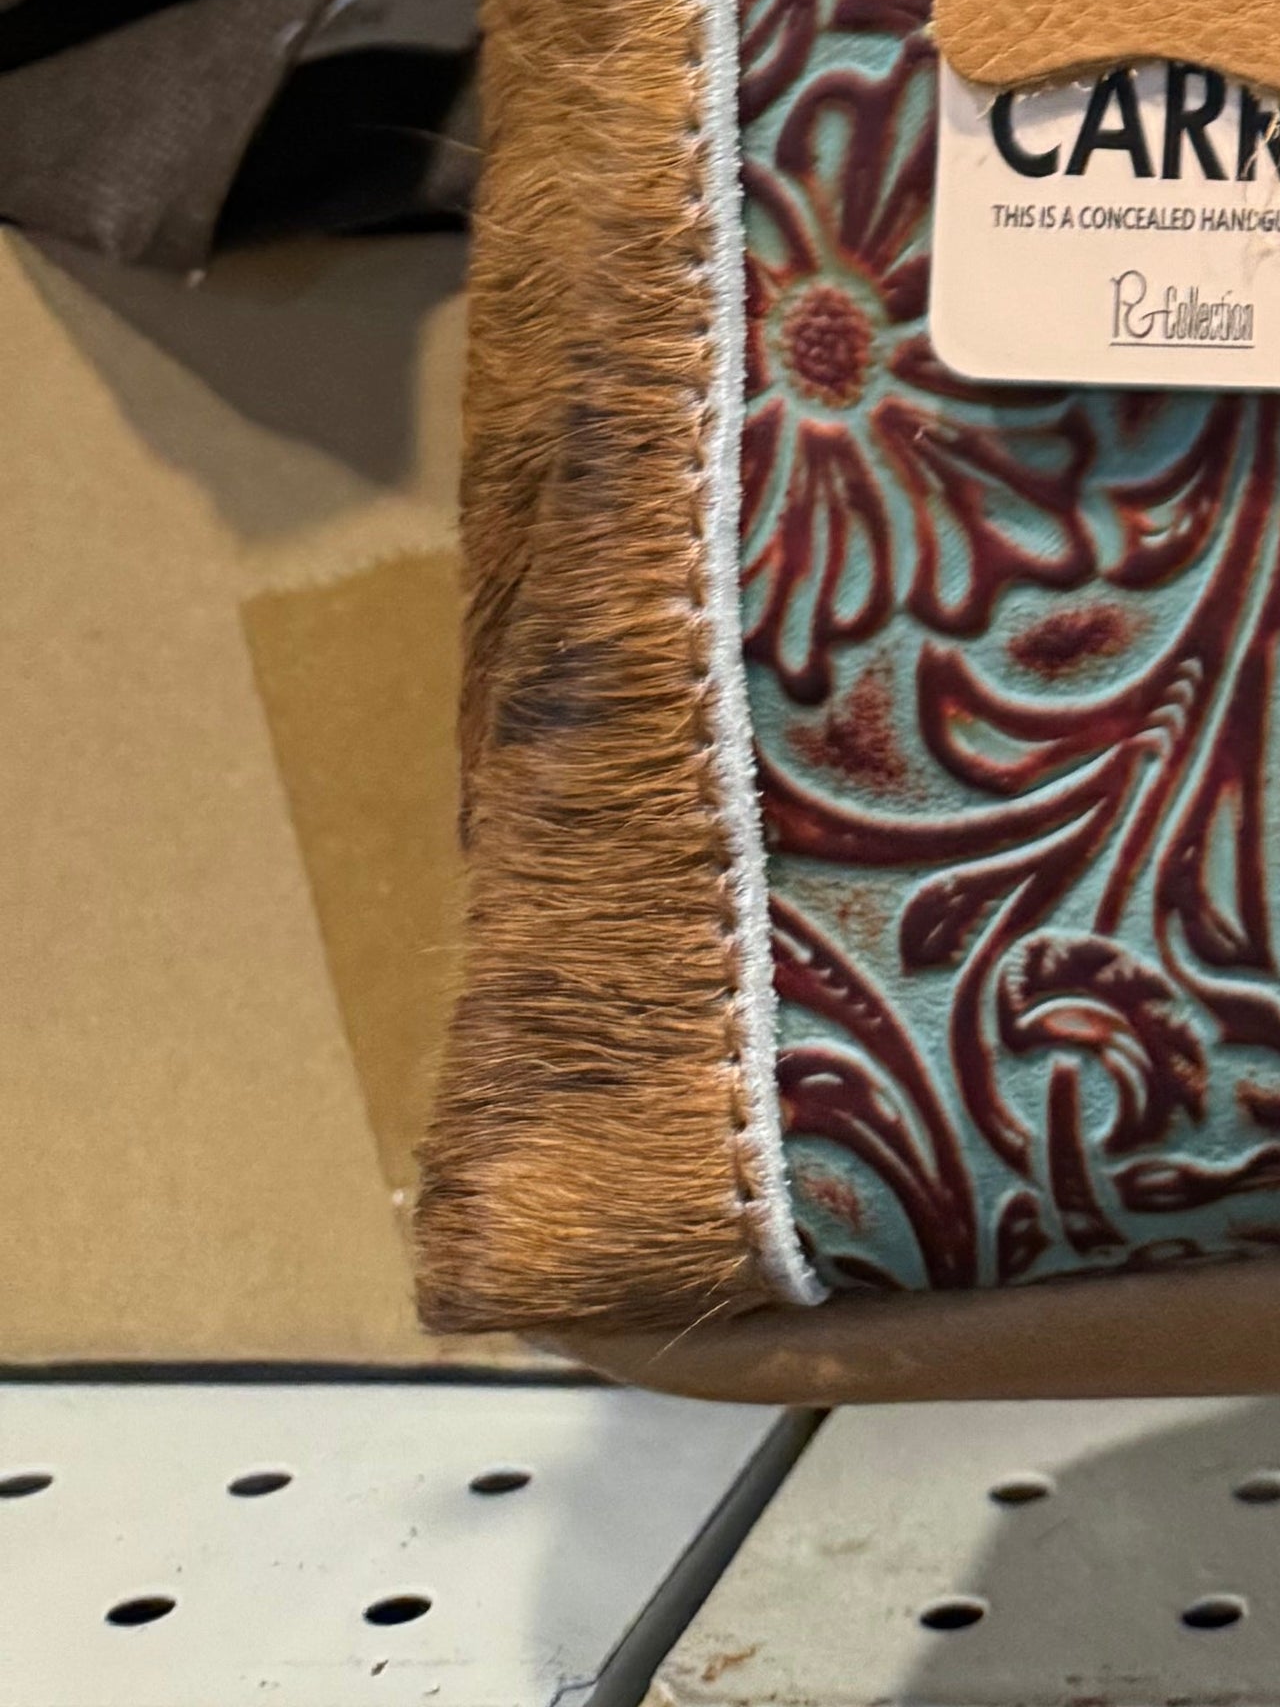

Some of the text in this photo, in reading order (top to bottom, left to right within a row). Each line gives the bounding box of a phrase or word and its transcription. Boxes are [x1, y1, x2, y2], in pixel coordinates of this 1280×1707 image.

[992, 204, 1036, 228] THIS
[1038, 205, 1056, 228] IS
[1059, 205, 1074, 229] A
[1079, 205, 1196, 231] CONCEALED
[1164, 285, 1254, 341] Collection
